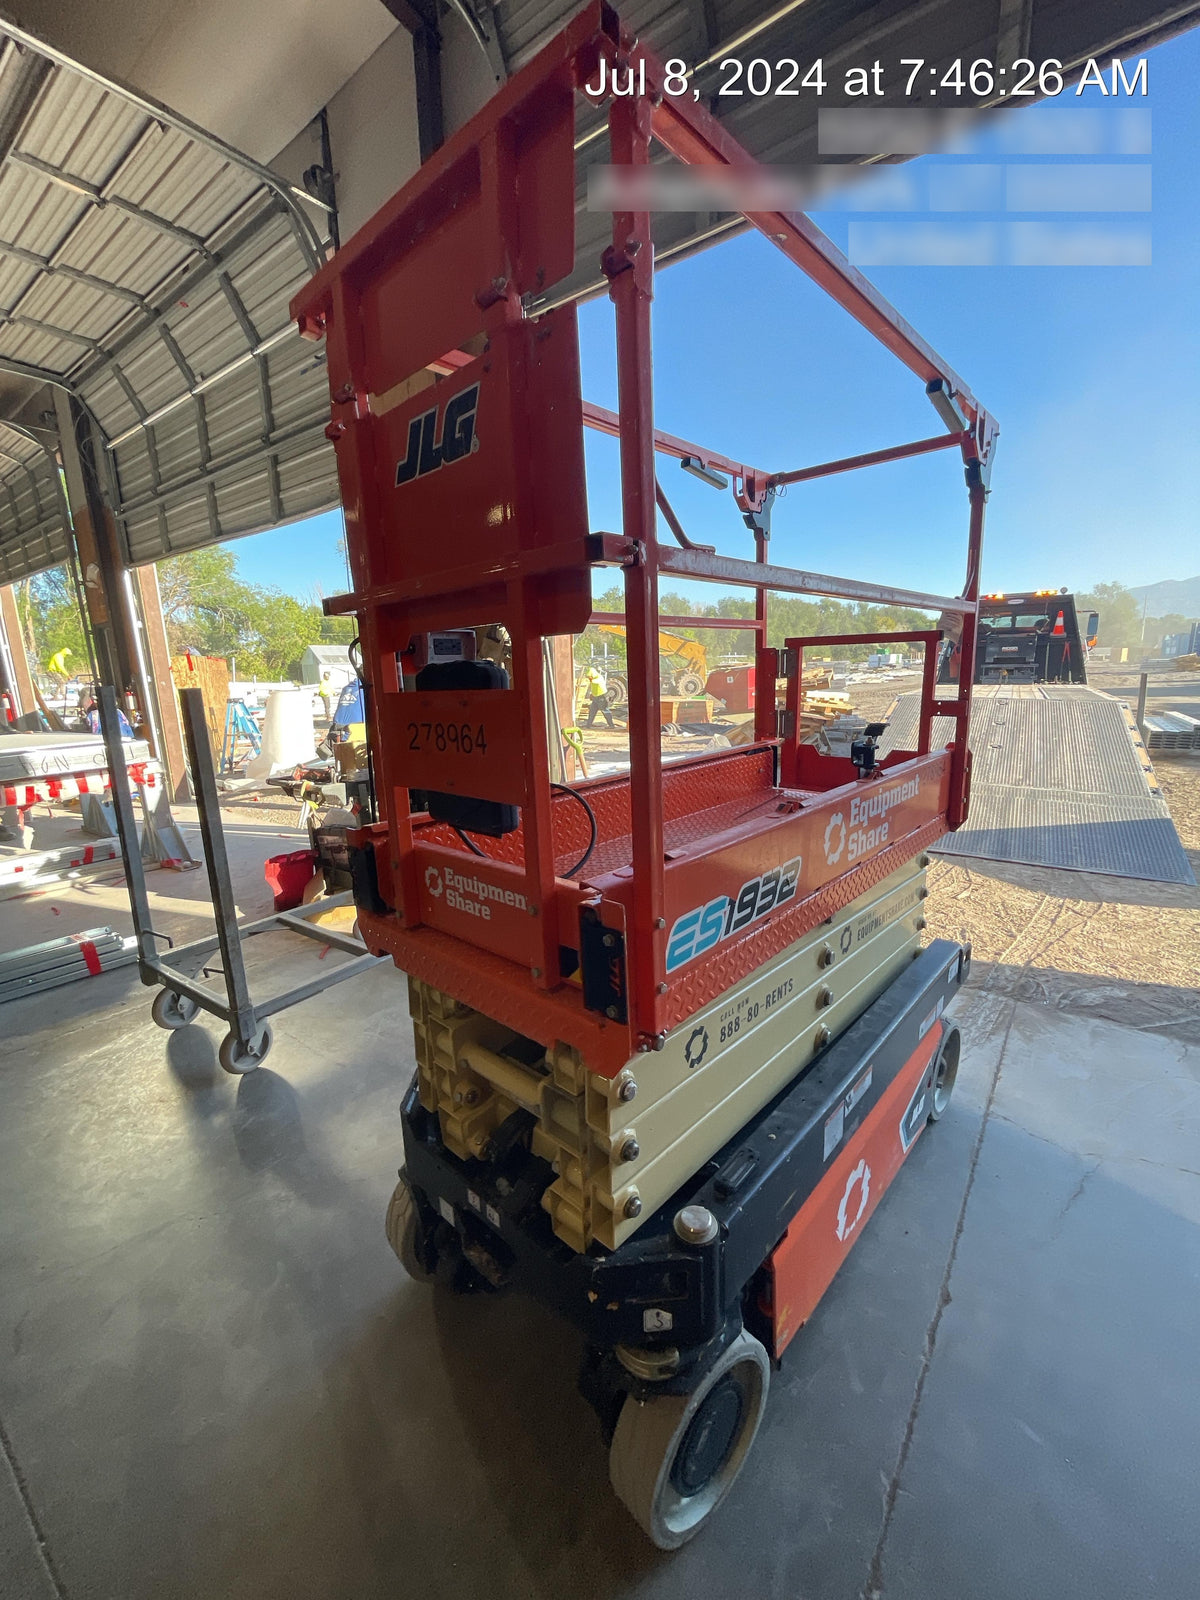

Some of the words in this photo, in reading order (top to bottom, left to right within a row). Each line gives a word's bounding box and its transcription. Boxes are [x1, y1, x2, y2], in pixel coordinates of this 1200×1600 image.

[394, 380, 481, 489] JLG
[407, 722, 487, 755] 278964
[849, 773, 920, 828] Equipment
[847, 821, 889, 862] Share
[445, 888, 492, 921] Share
[665, 855, 802, 975] ES1932
[719, 977, 794, 1043] 888-80-RENTS
